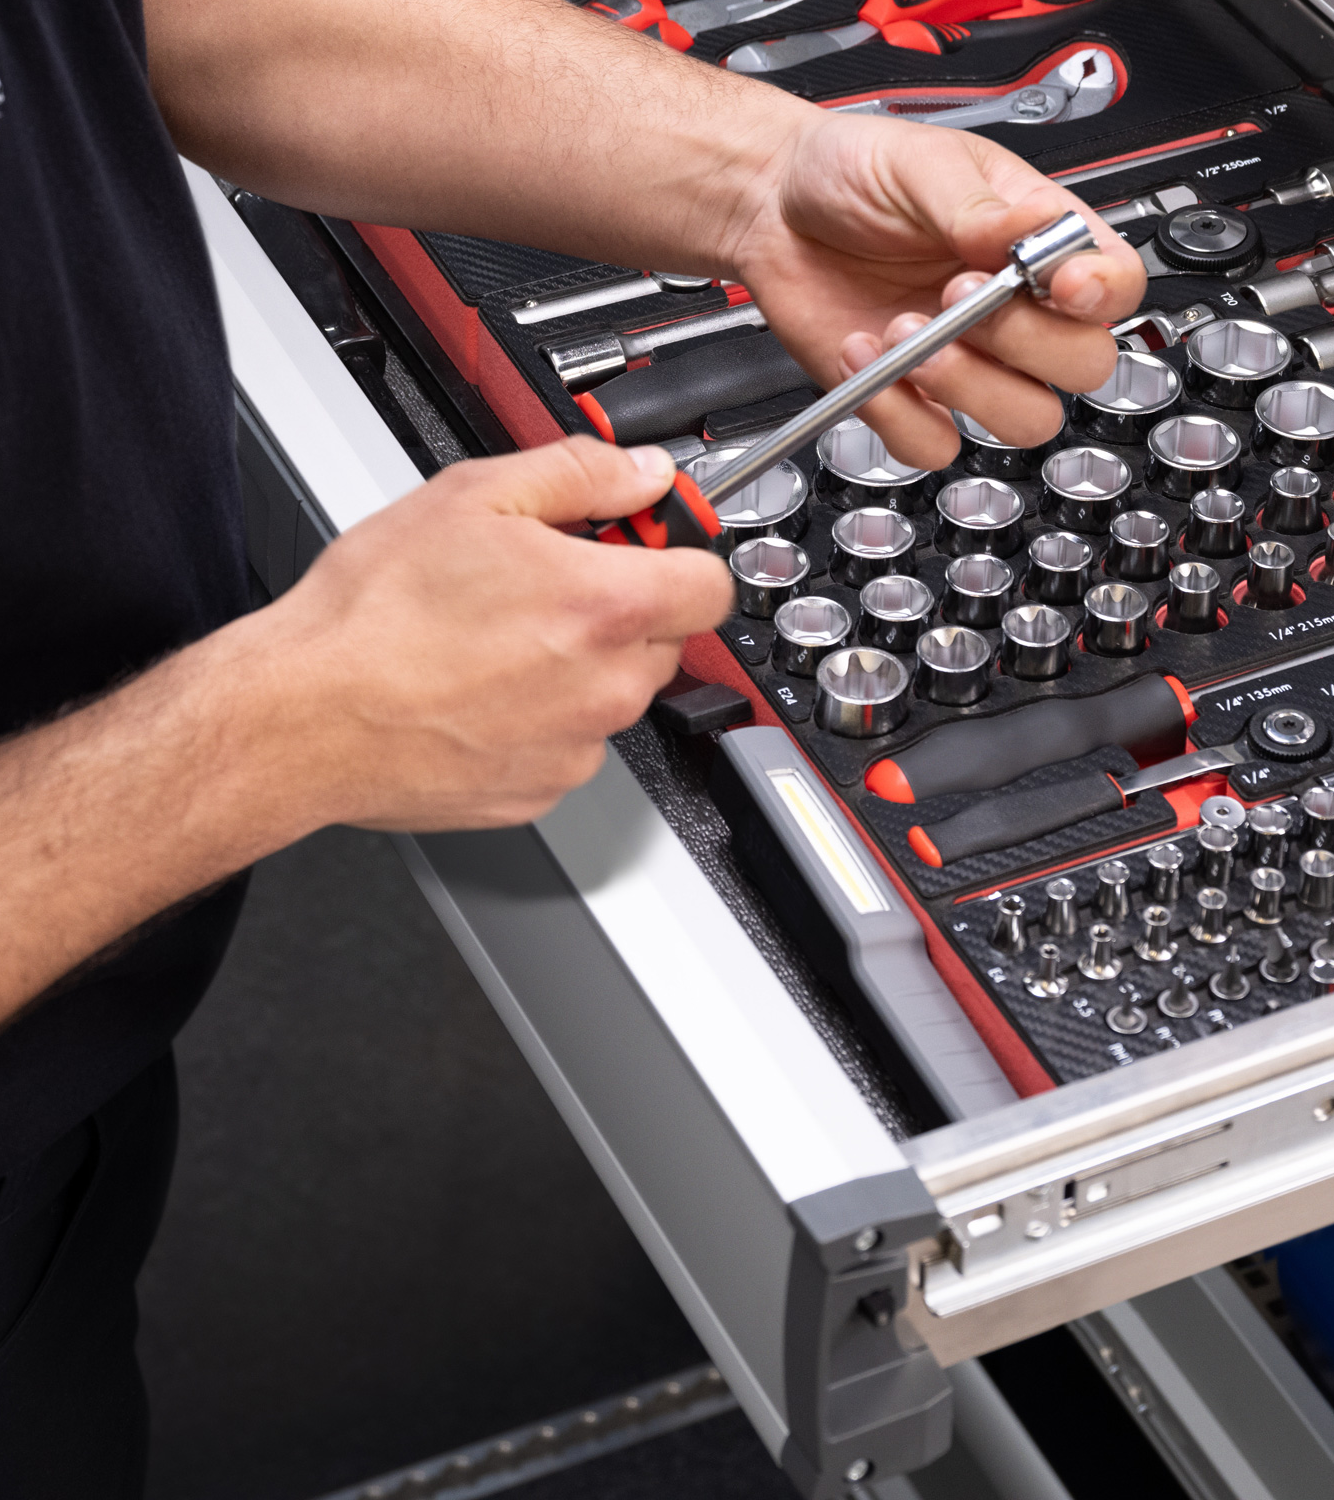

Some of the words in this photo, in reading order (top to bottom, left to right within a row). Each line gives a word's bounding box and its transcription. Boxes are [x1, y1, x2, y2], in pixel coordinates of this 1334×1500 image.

[1264, 103, 1288, 115] 1/2"
[1196, 165, 1221, 178] 1/2"
[1221, 156, 1262, 172] 250mm
[1220, 291, 1239, 307] T20
[738, 634, 755, 646] 17
[1268, 625, 1296, 641] 1/4"
[777, 686, 798, 706] E24
[1215, 695, 1244, 712] 1/4"
[1246, 683, 1293, 702] 135mm
[1241, 767, 1271, 785] 1/4"
[953, 922, 969, 932] 5
